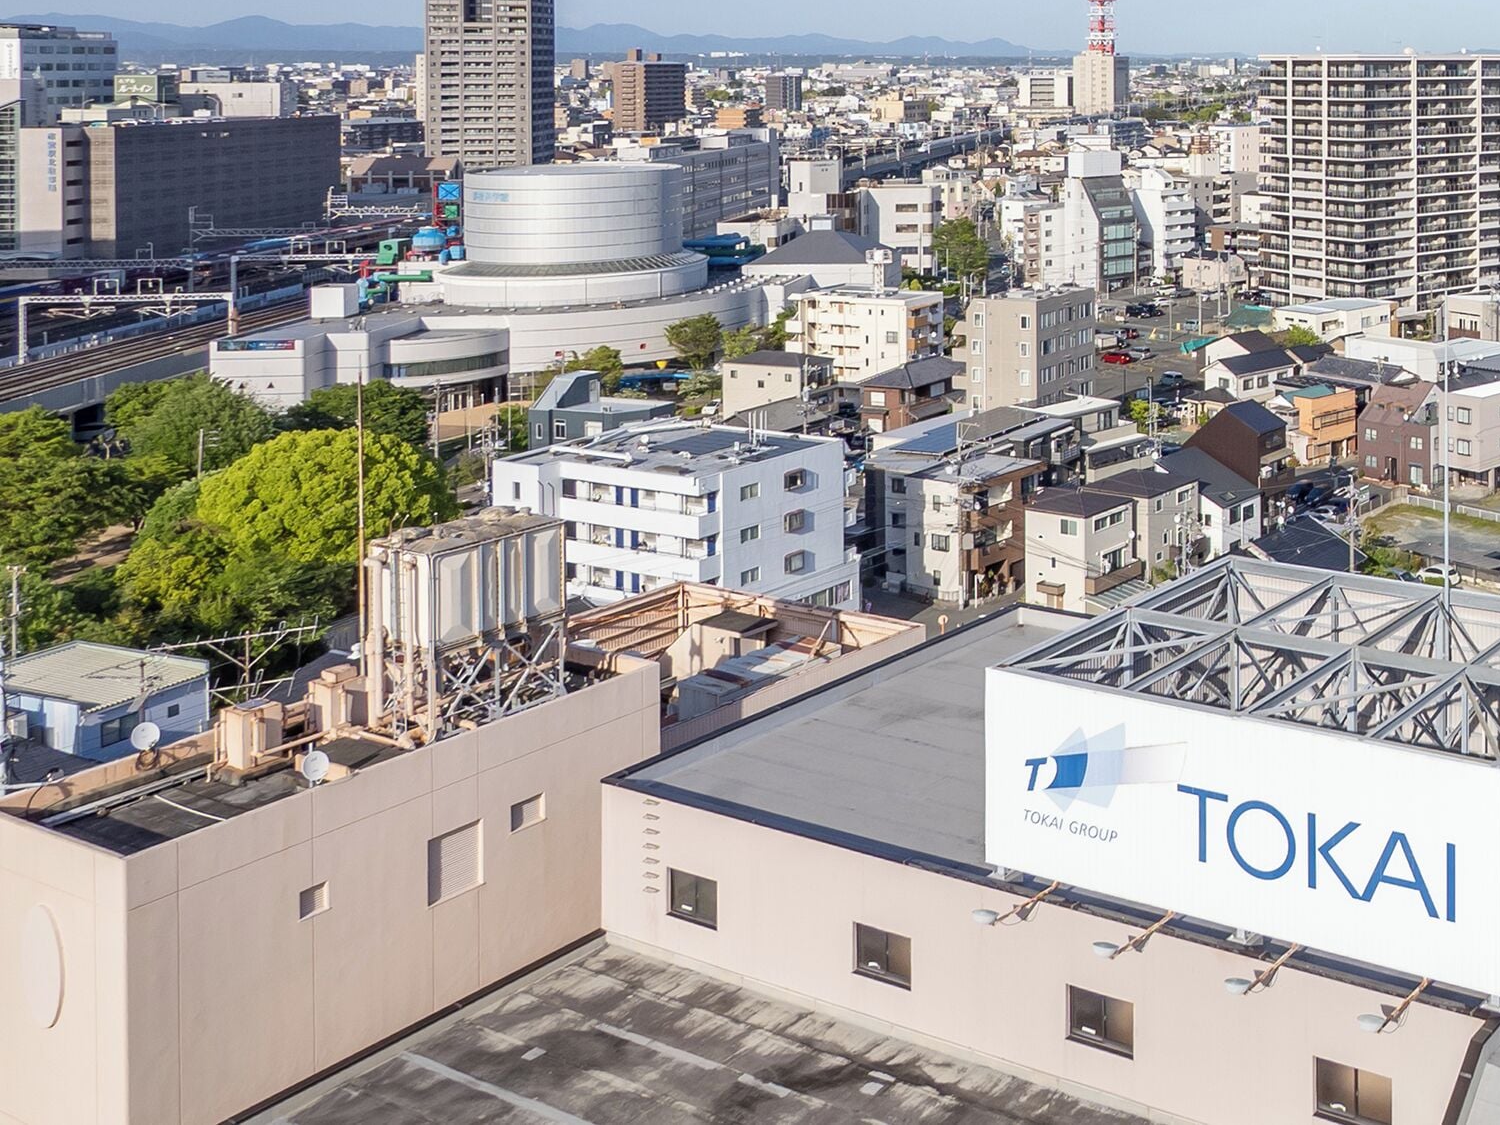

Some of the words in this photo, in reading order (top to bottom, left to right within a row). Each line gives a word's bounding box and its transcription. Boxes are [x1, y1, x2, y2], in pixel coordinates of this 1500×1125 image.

[1024, 808, 1064, 831] TOKAI
[1068, 820, 1118, 843] GROUP
[1177, 783, 1456, 923] TOKAI
